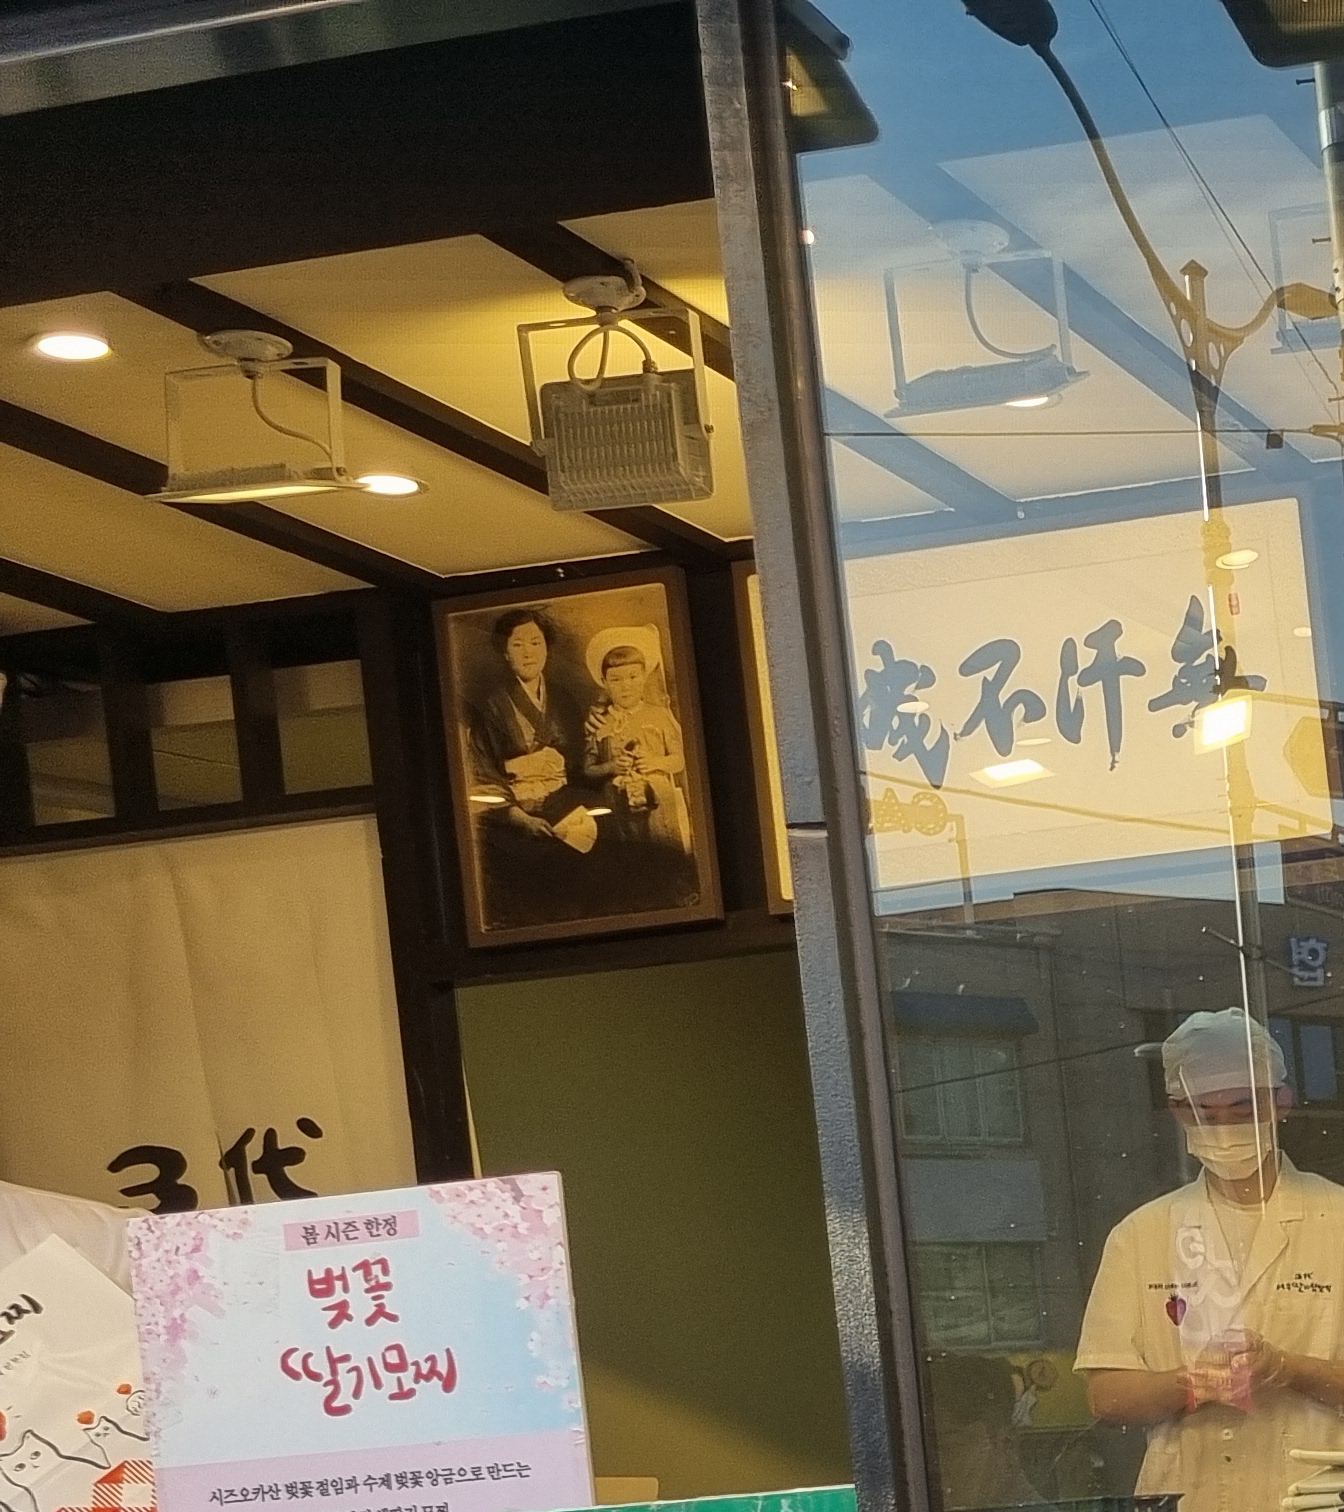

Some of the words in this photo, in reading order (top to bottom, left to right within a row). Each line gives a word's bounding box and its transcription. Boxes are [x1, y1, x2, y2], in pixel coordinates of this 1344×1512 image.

[301, 1224, 320, 1245] 봄
[324, 1219, 359, 1243] 시즌
[364, 1215, 399, 1237] 한정
[307, 1257, 400, 1330] 벚꽃
[280, 1343, 458, 1417] 딸기모찌
[209, 1485, 281, 1507] 시즈오카산
[363, 1473, 392, 1494] 수제
[486, 1460, 532, 1482] 만드는
